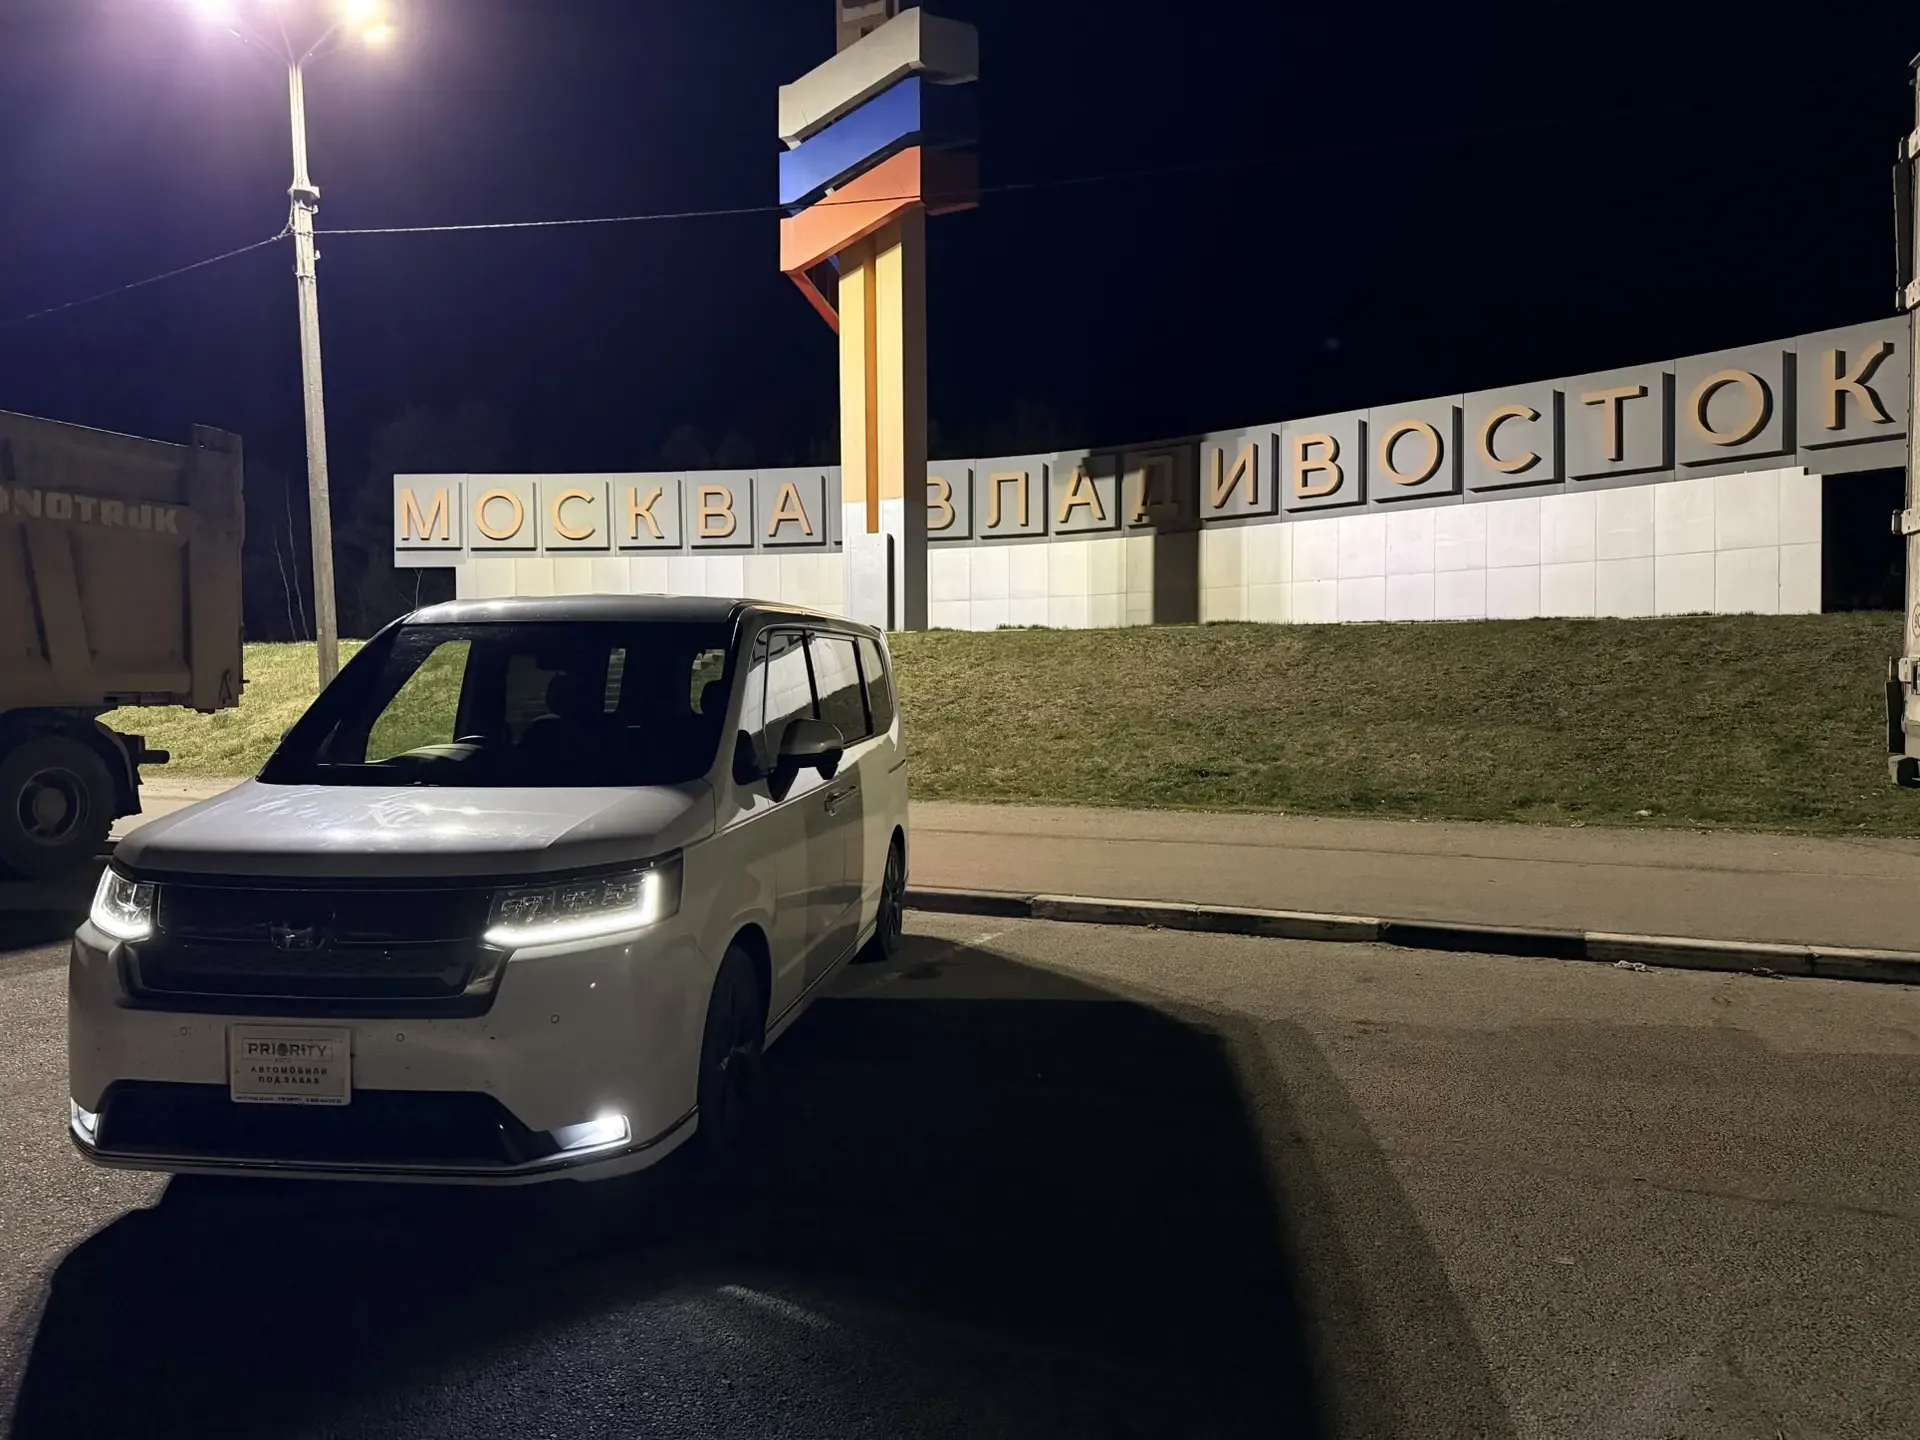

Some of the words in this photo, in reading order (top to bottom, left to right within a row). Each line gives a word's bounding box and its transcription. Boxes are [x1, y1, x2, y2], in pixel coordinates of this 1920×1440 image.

[400, 482, 814, 540] МОСКВА
[926, 340, 1896, 530] ВЛАДИВОСТОК
[248, 1042, 327, 1057] PRIORITY
[250, 1066, 328, 1075] АВТОМОБИЛИ
